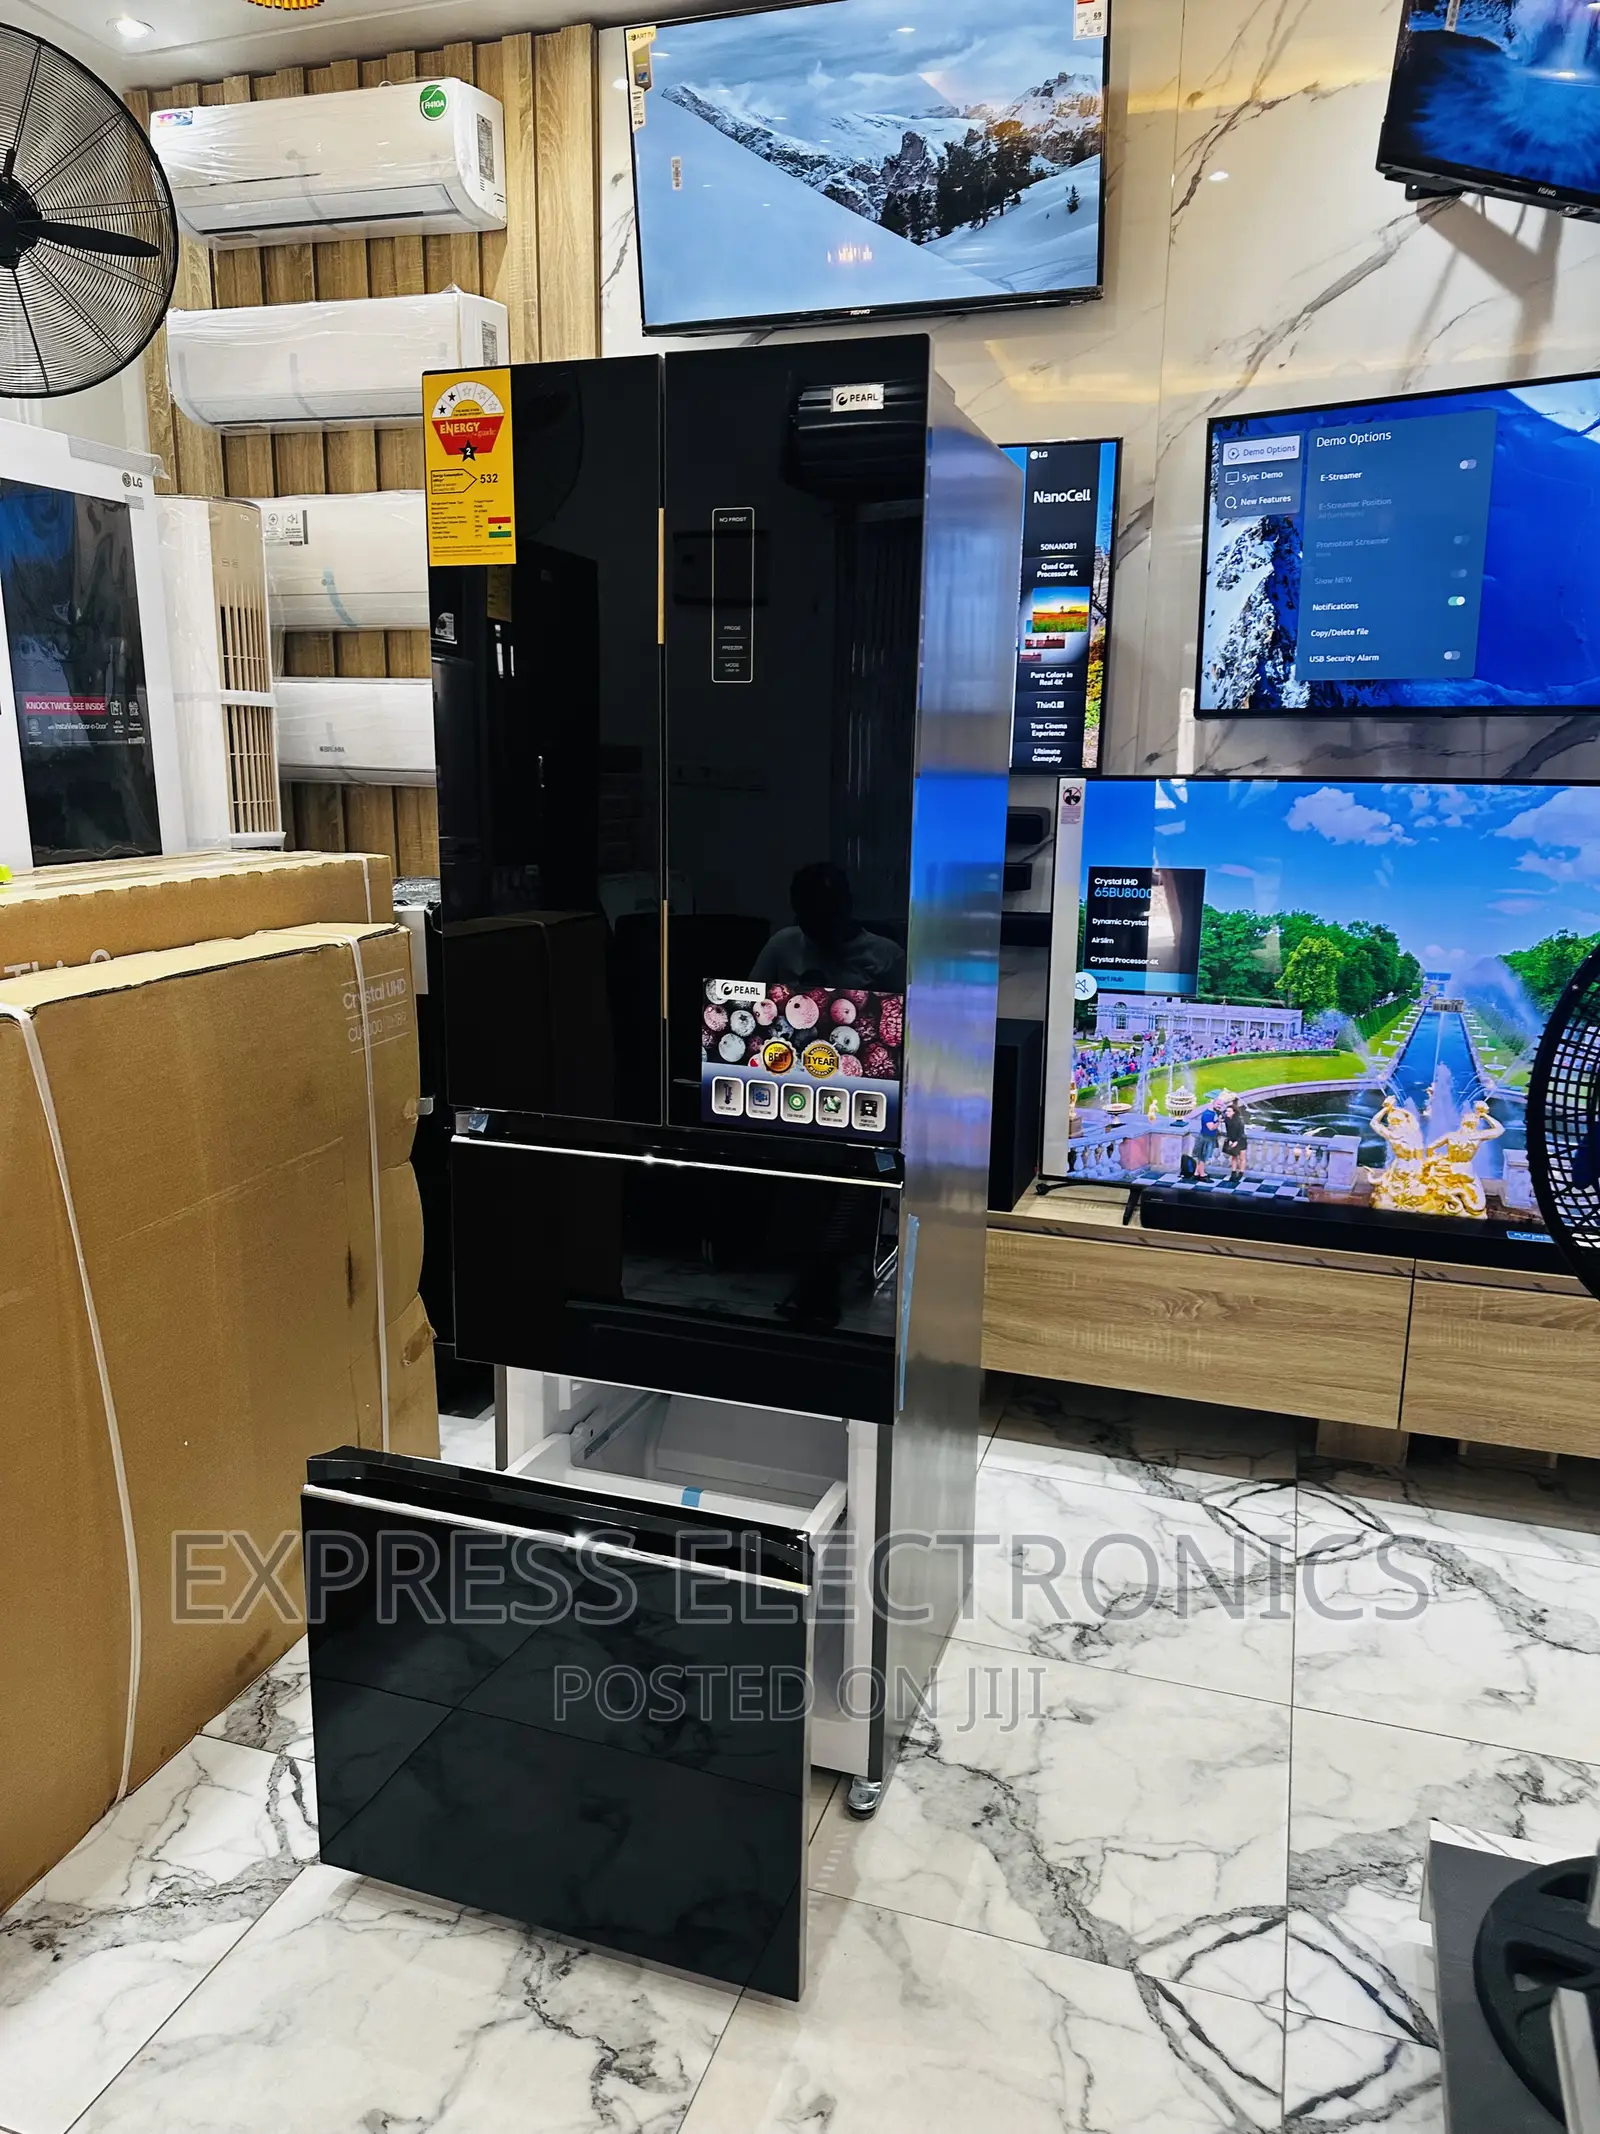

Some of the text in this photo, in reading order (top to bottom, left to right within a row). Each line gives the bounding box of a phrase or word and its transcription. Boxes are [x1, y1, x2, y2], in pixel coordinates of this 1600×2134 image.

[849, 393, 878, 402] PEARL
[440, 421, 480, 436] ENERGY
[1316, 431, 1392, 448] Demo Options
[466, 447, 471, 455] 2
[1243, 445, 1296, 457] Demo Options
[132, 476, 143, 488] LG
[480, 473, 498, 484] 532
[1241, 471, 1284, 483] Sync Demo
[1320, 472, 1362, 482] E-Streamer
[1033, 489, 1091, 503] NanoCell
[1240, 495, 1291, 506] New Features
[1068, 569, 1078, 577] 4K
[1312, 603, 1359, 612] Notifications
[1310, 628, 1355, 638] Copy/Delete
[1326, 654, 1356, 664] Security
[1357, 654, 1380, 662] Alarm
[26, 701, 106, 711] KNOCK TWICE, SEE INSIDE
[1032, 730, 1065, 738] Experience
[1032, 755, 1062, 763] Gameplay
[1094, 878, 1122, 886] Crystal
[1092, 918, 1148, 927] Dynamic Crystal
[1115, 957, 1149, 965] Processor
[386, 978, 407, 998] UHD
[734, 985, 761, 995] PEARL
[768, 1053, 788, 1063] BEST
[811, 1057, 835, 1066] YEAR
